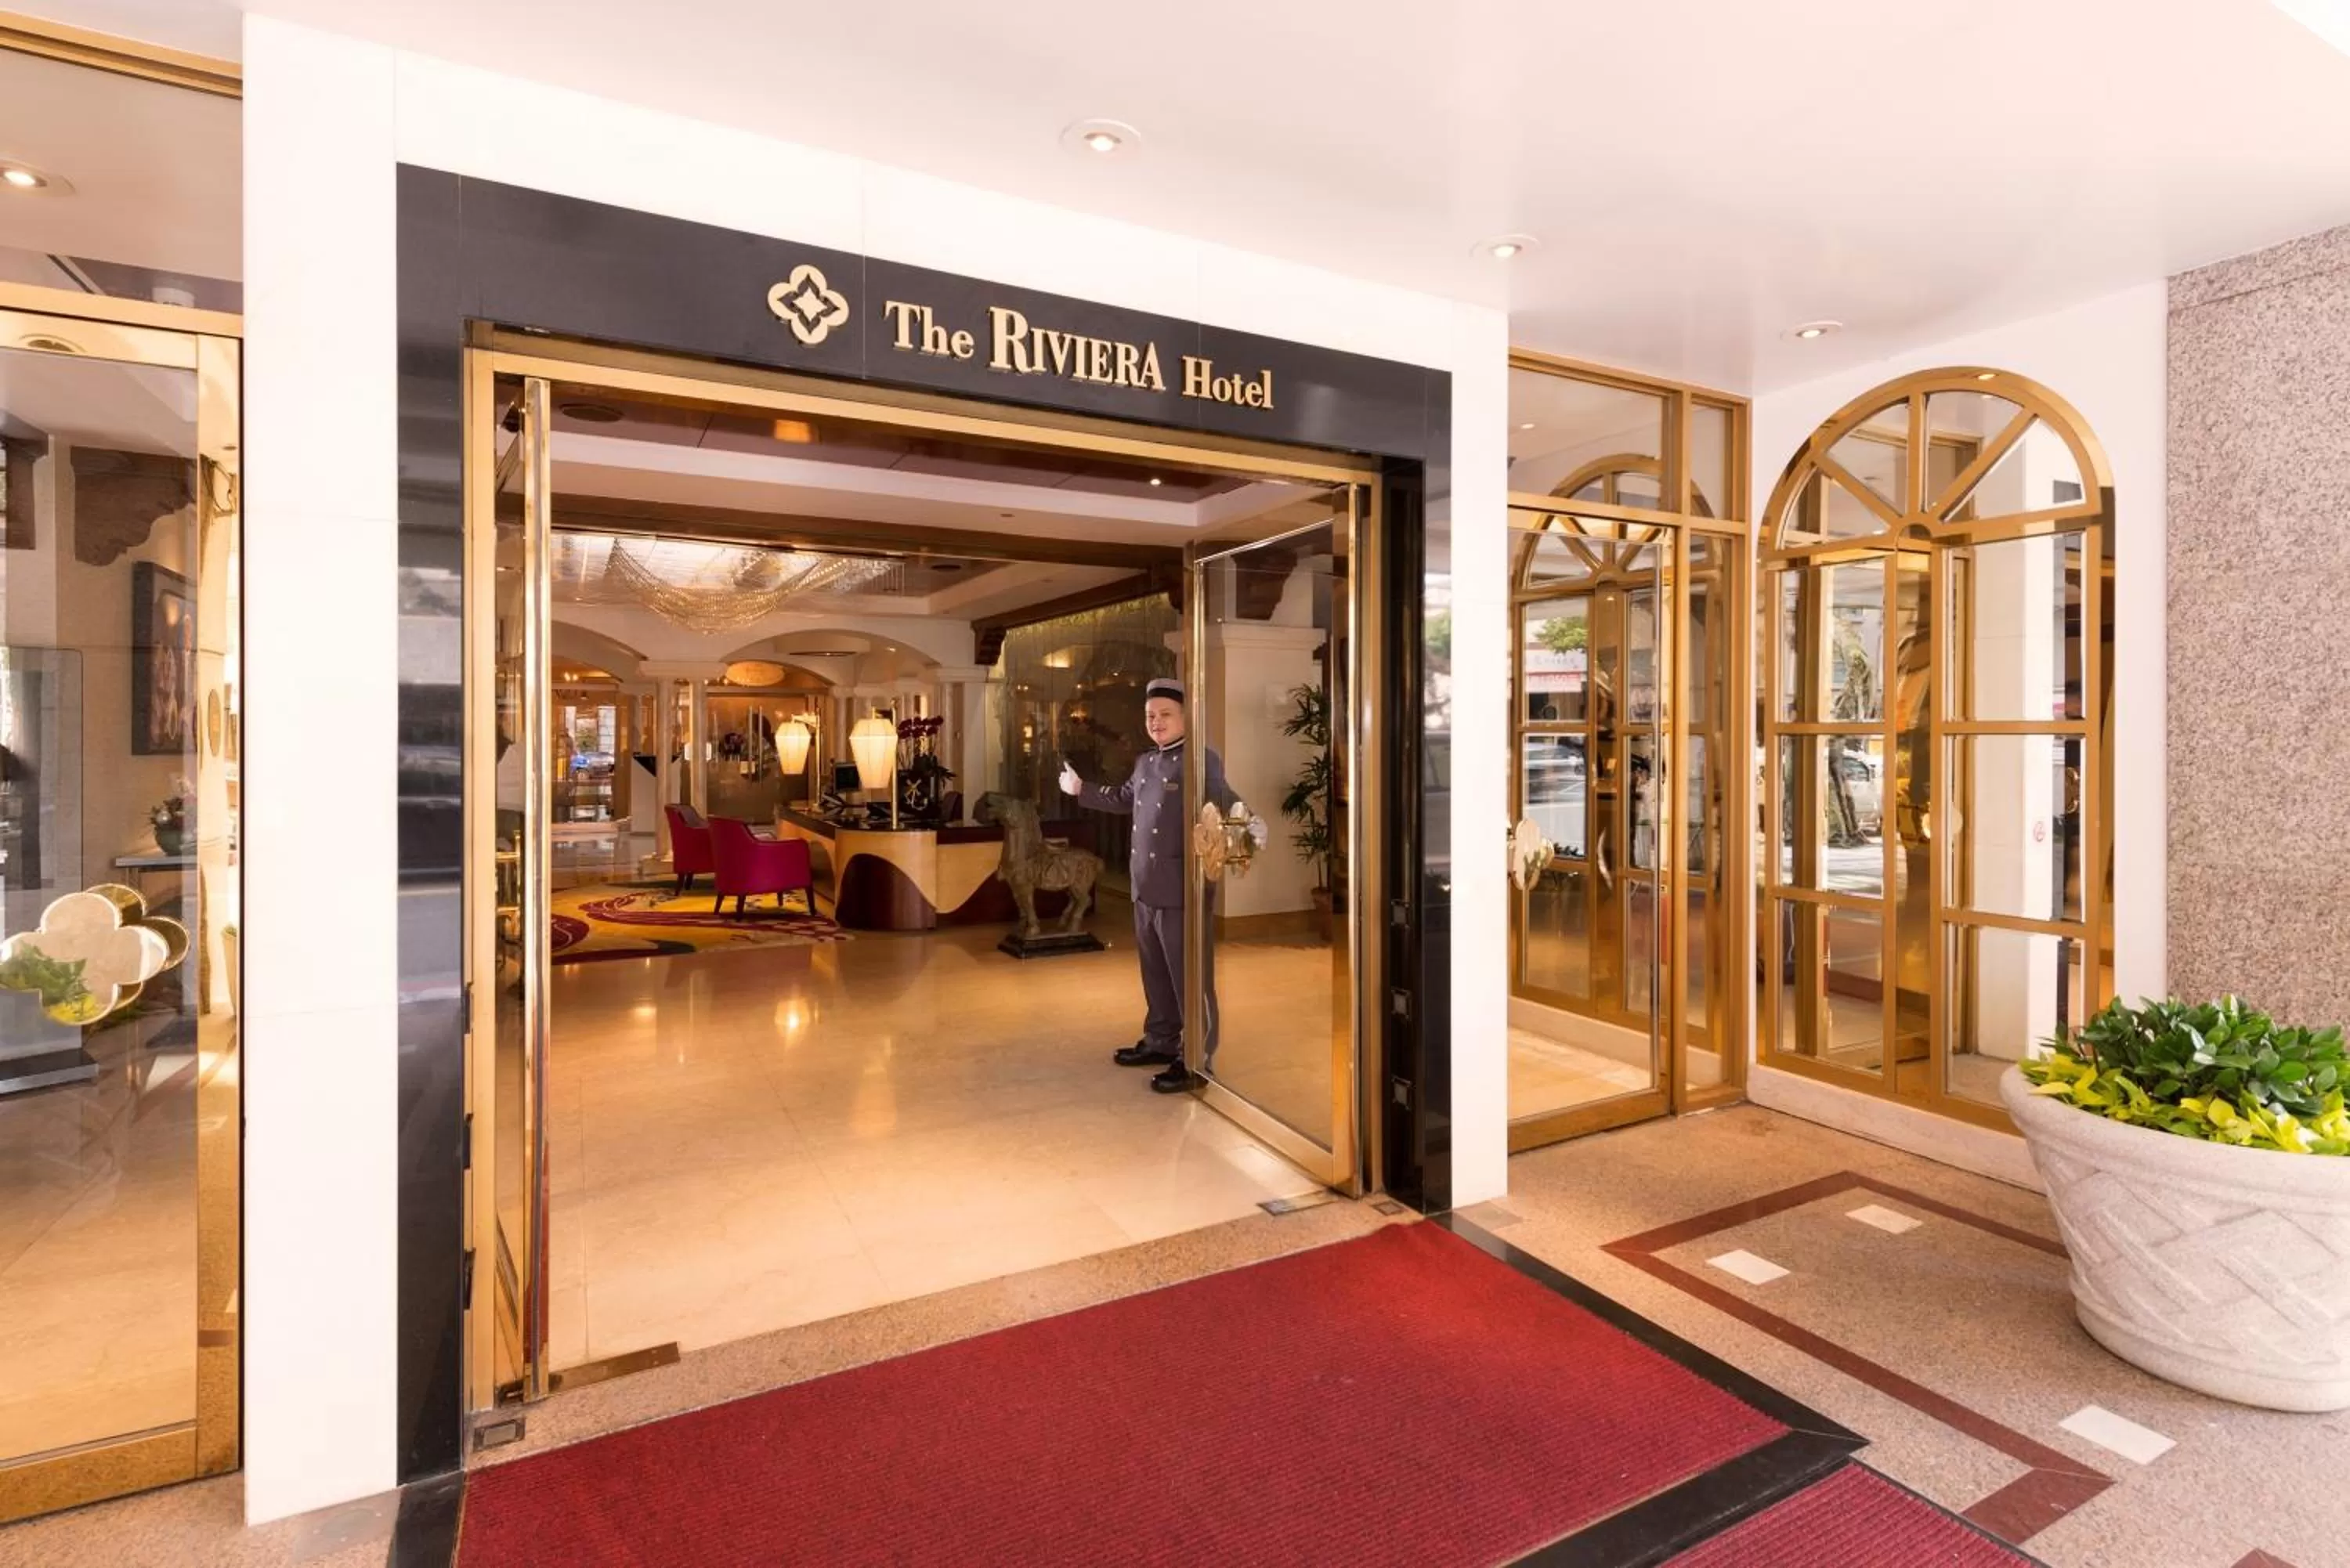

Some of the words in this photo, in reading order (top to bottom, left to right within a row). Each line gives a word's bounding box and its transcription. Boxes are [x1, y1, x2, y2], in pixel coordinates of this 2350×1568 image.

[884, 299, 974, 359] The
[989, 305, 1166, 391] RIVIERA
[1181, 355, 1274, 408] Hotel
